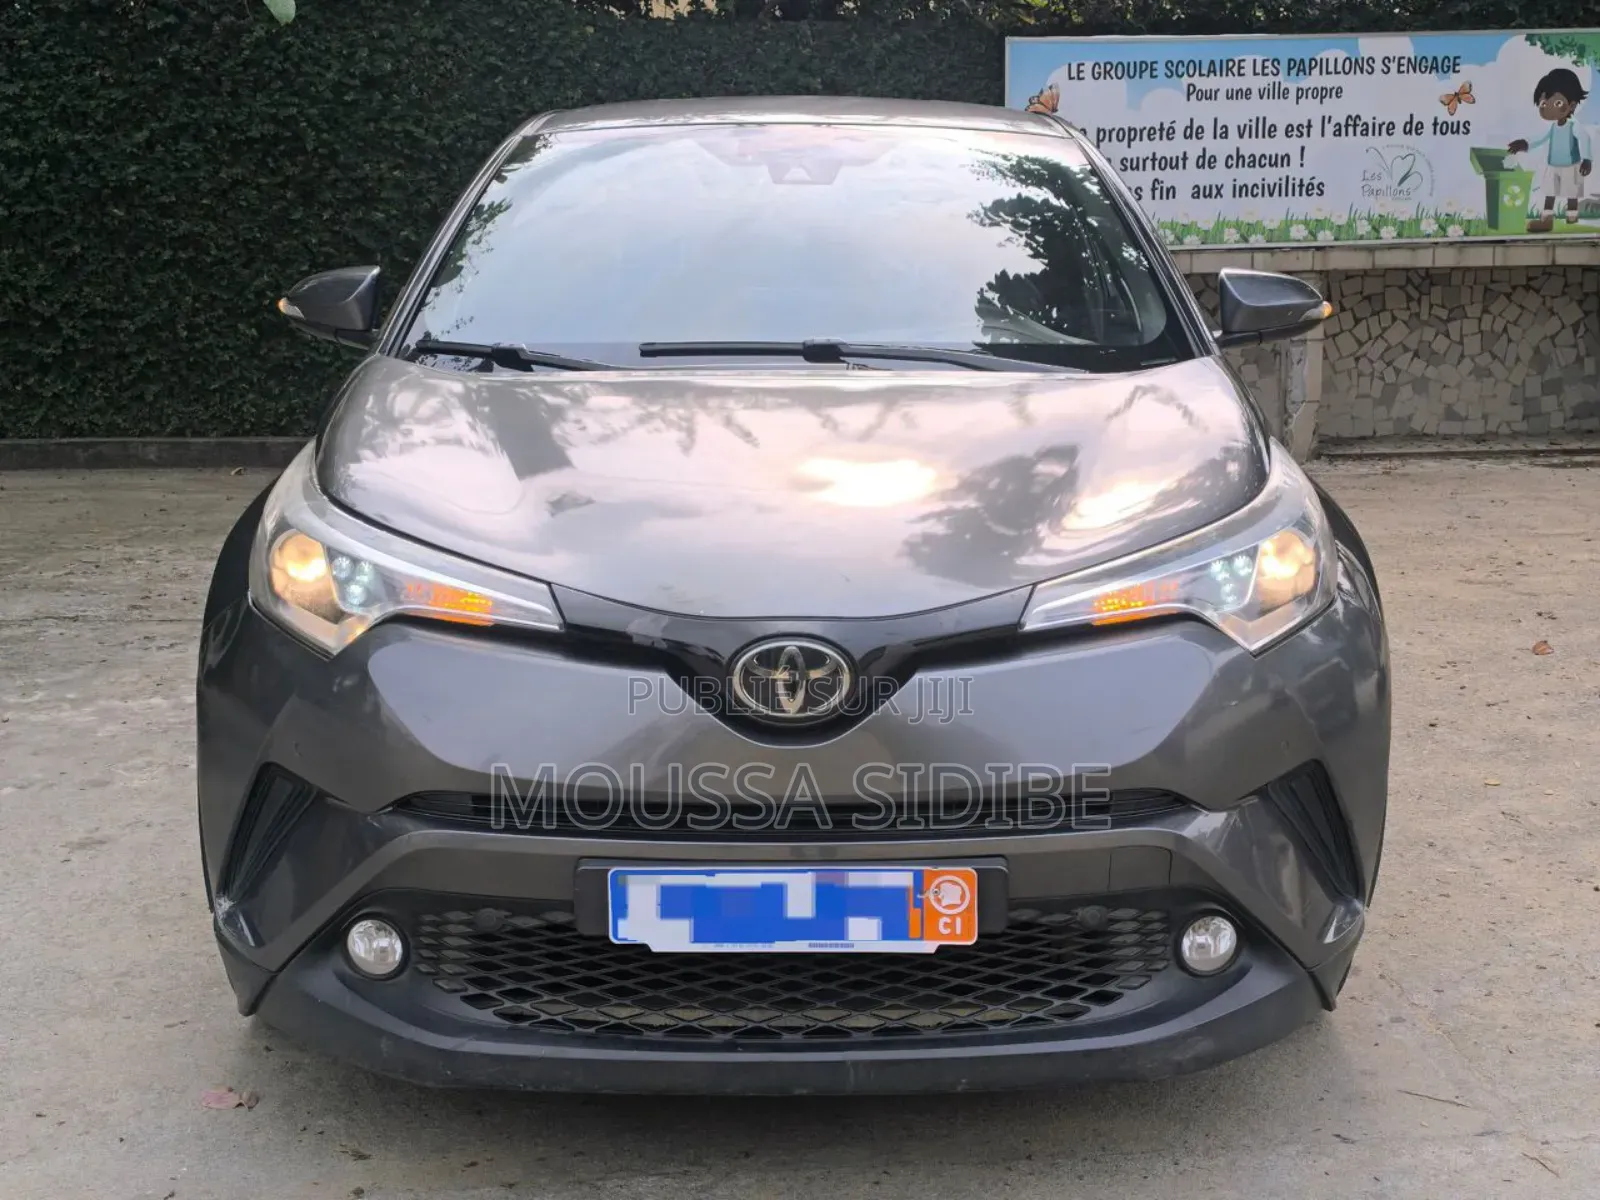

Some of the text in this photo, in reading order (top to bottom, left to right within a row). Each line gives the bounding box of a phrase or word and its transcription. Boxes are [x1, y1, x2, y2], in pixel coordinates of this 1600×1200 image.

[1067, 55, 1461, 80] LE GROUPE SCOLAIRE LES PAPILLONS S'ENGAGE
[1186, 81, 1343, 104] Pour une ville propre
[1096, 113, 1471, 149] propreté de la ville est l'affaire de tous
[1120, 151, 1189, 172] surtout
[1196, 147, 1217, 170] de
[1225, 147, 1291, 169] chacun
[1361, 169, 1382, 181] Les
[1151, 178, 1177, 201] fin
[1190, 182, 1224, 199] aux
[1232, 175, 1325, 199] incivilités
[1361, 184, 1412, 200] Papillons
[938, 917, 962, 935] CI
